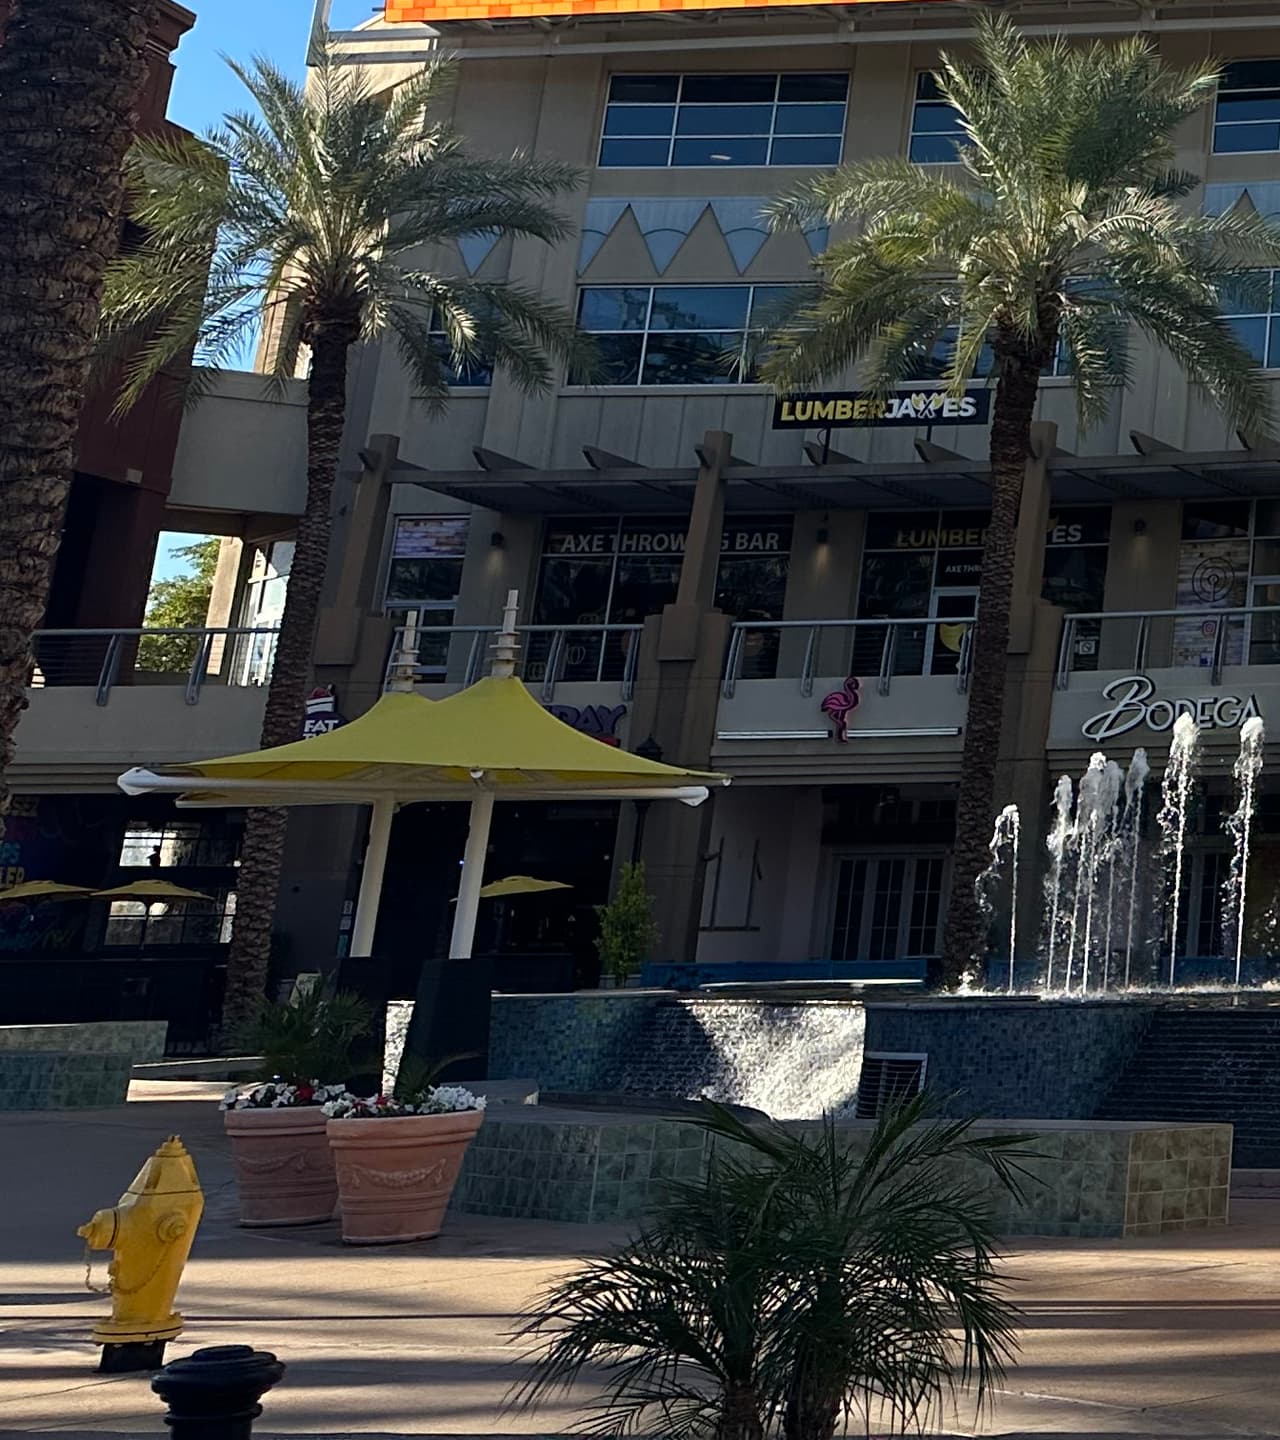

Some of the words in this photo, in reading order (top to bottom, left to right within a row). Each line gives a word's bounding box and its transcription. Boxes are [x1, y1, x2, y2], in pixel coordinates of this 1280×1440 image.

[560, 533, 605, 552] AXE
[735, 532, 779, 551] BAR
[304, 720, 339, 733] FAT
